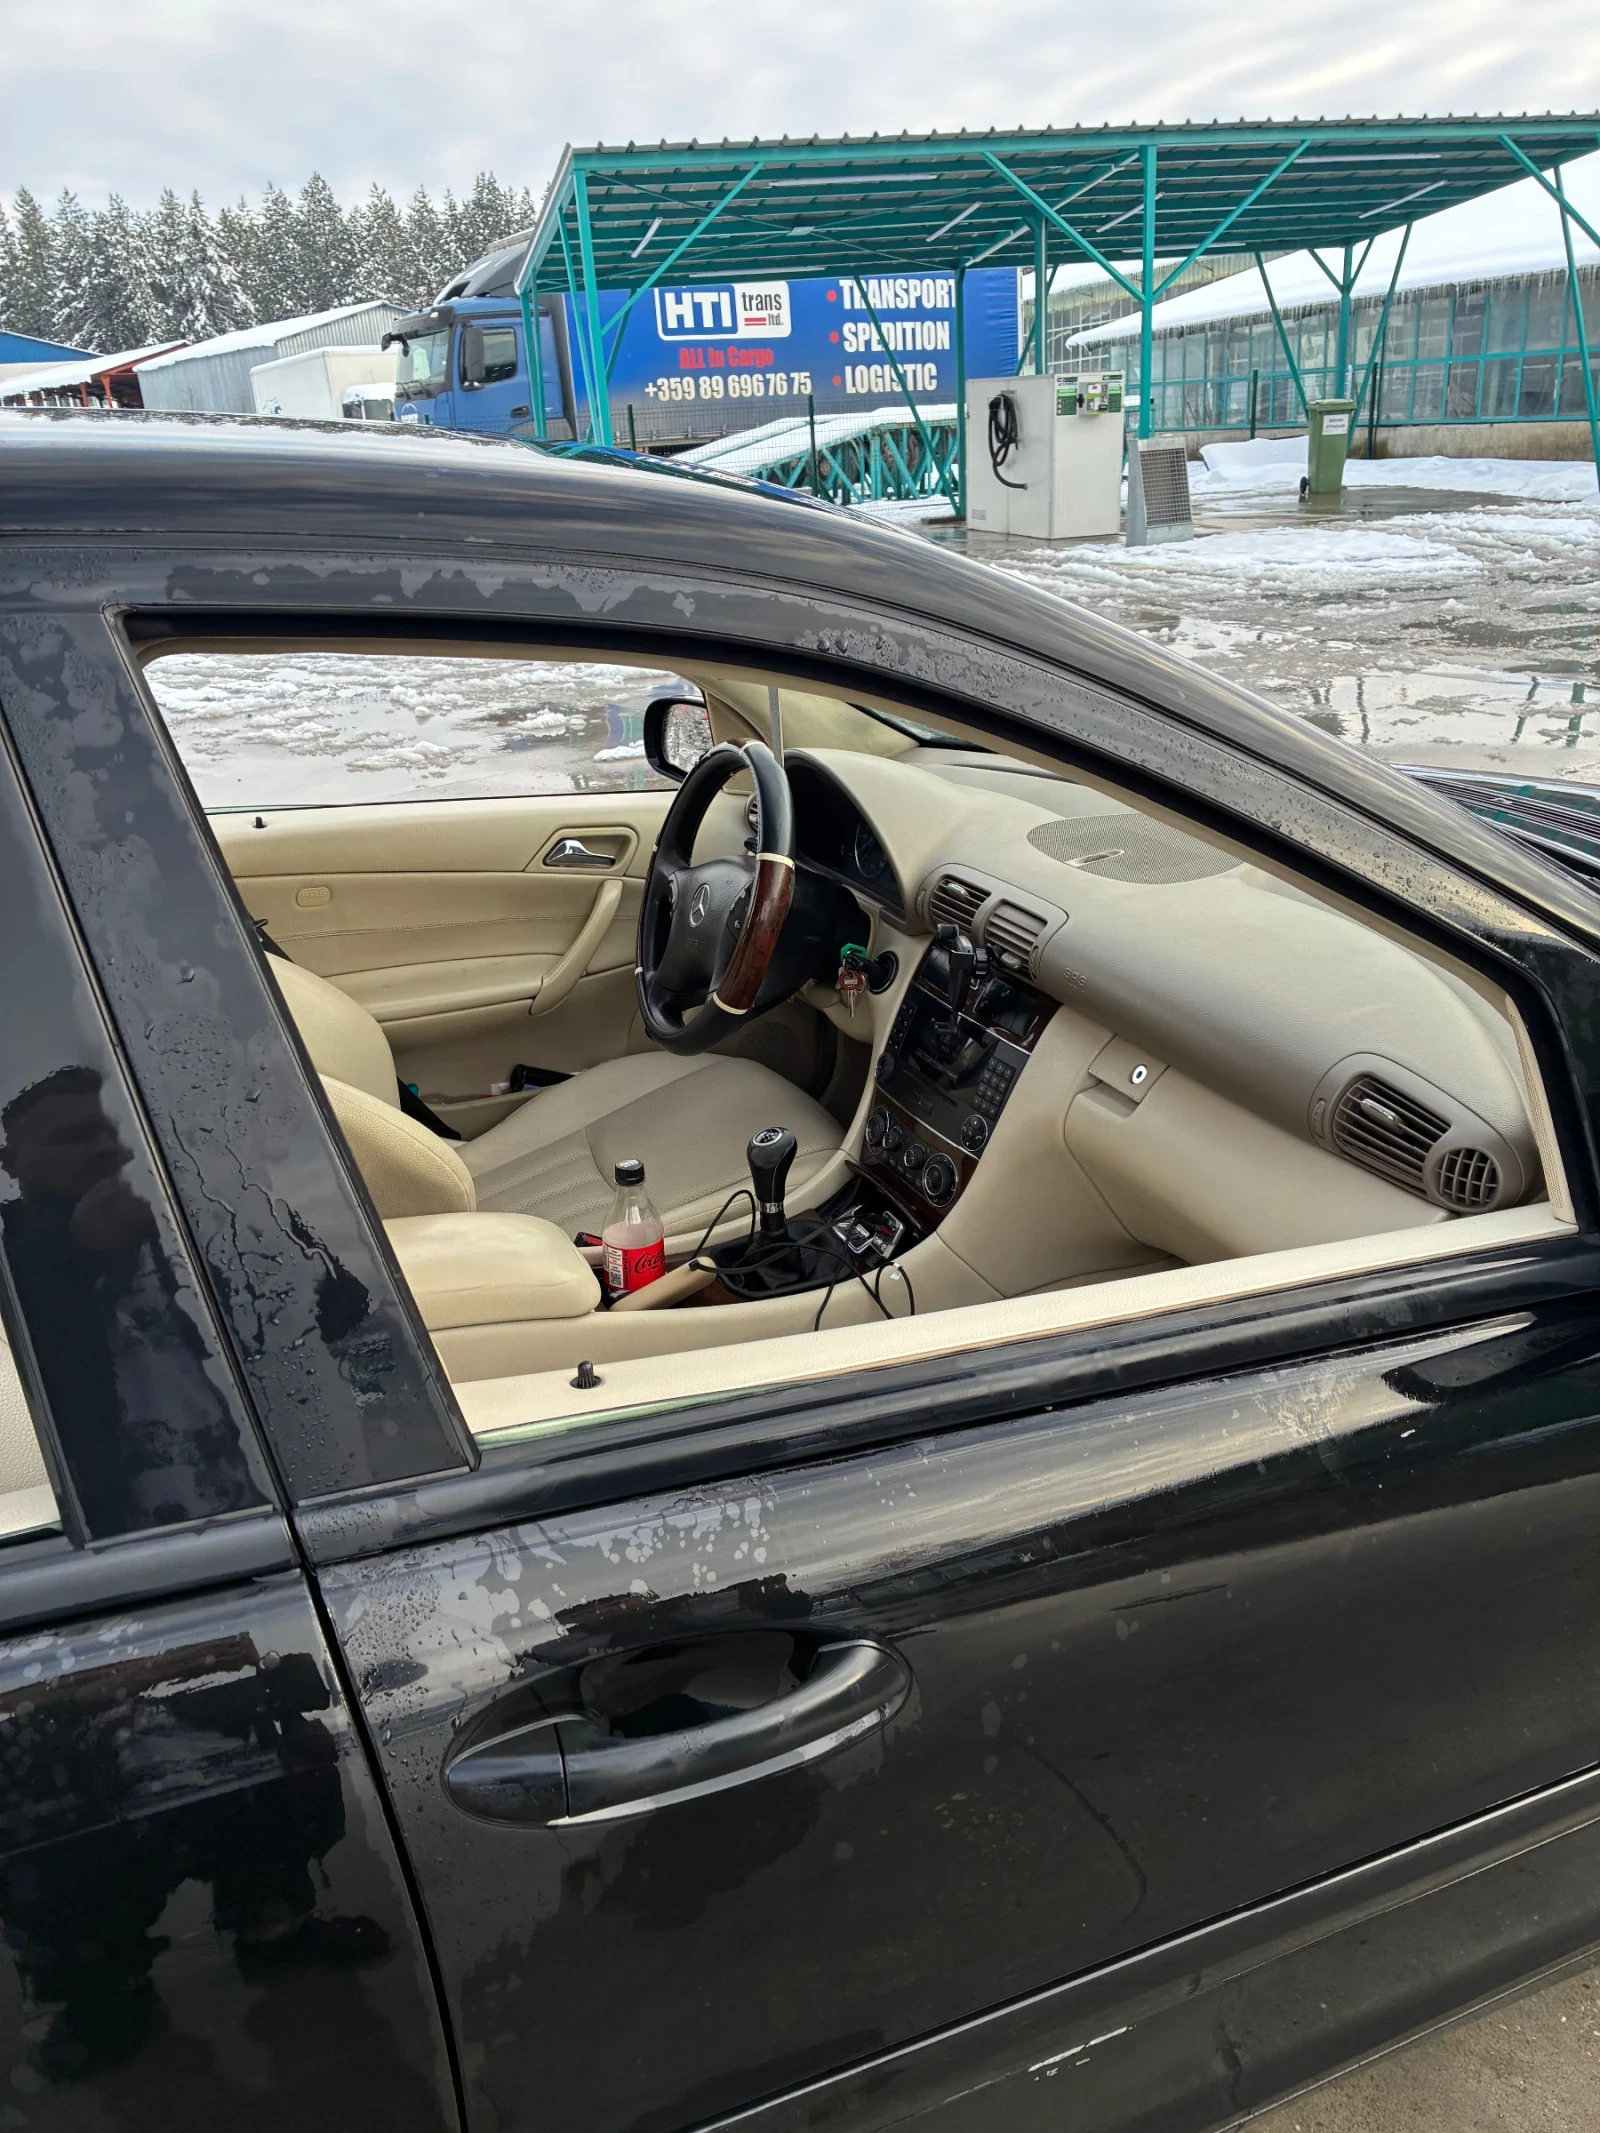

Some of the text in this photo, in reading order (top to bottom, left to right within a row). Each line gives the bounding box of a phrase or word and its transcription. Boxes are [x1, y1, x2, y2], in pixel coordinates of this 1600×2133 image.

[664, 291, 733, 329] HTI
[741, 292, 783, 312] trans
[768, 312, 784, 326] ltd.
[843, 320, 950, 352] SPEDITION
[679, 345, 774, 370] ALL In Cargo
[644, 376, 696, 402] +359
[699, 375, 725, 400] 89
[844, 362, 938, 394] LOGISTIC
